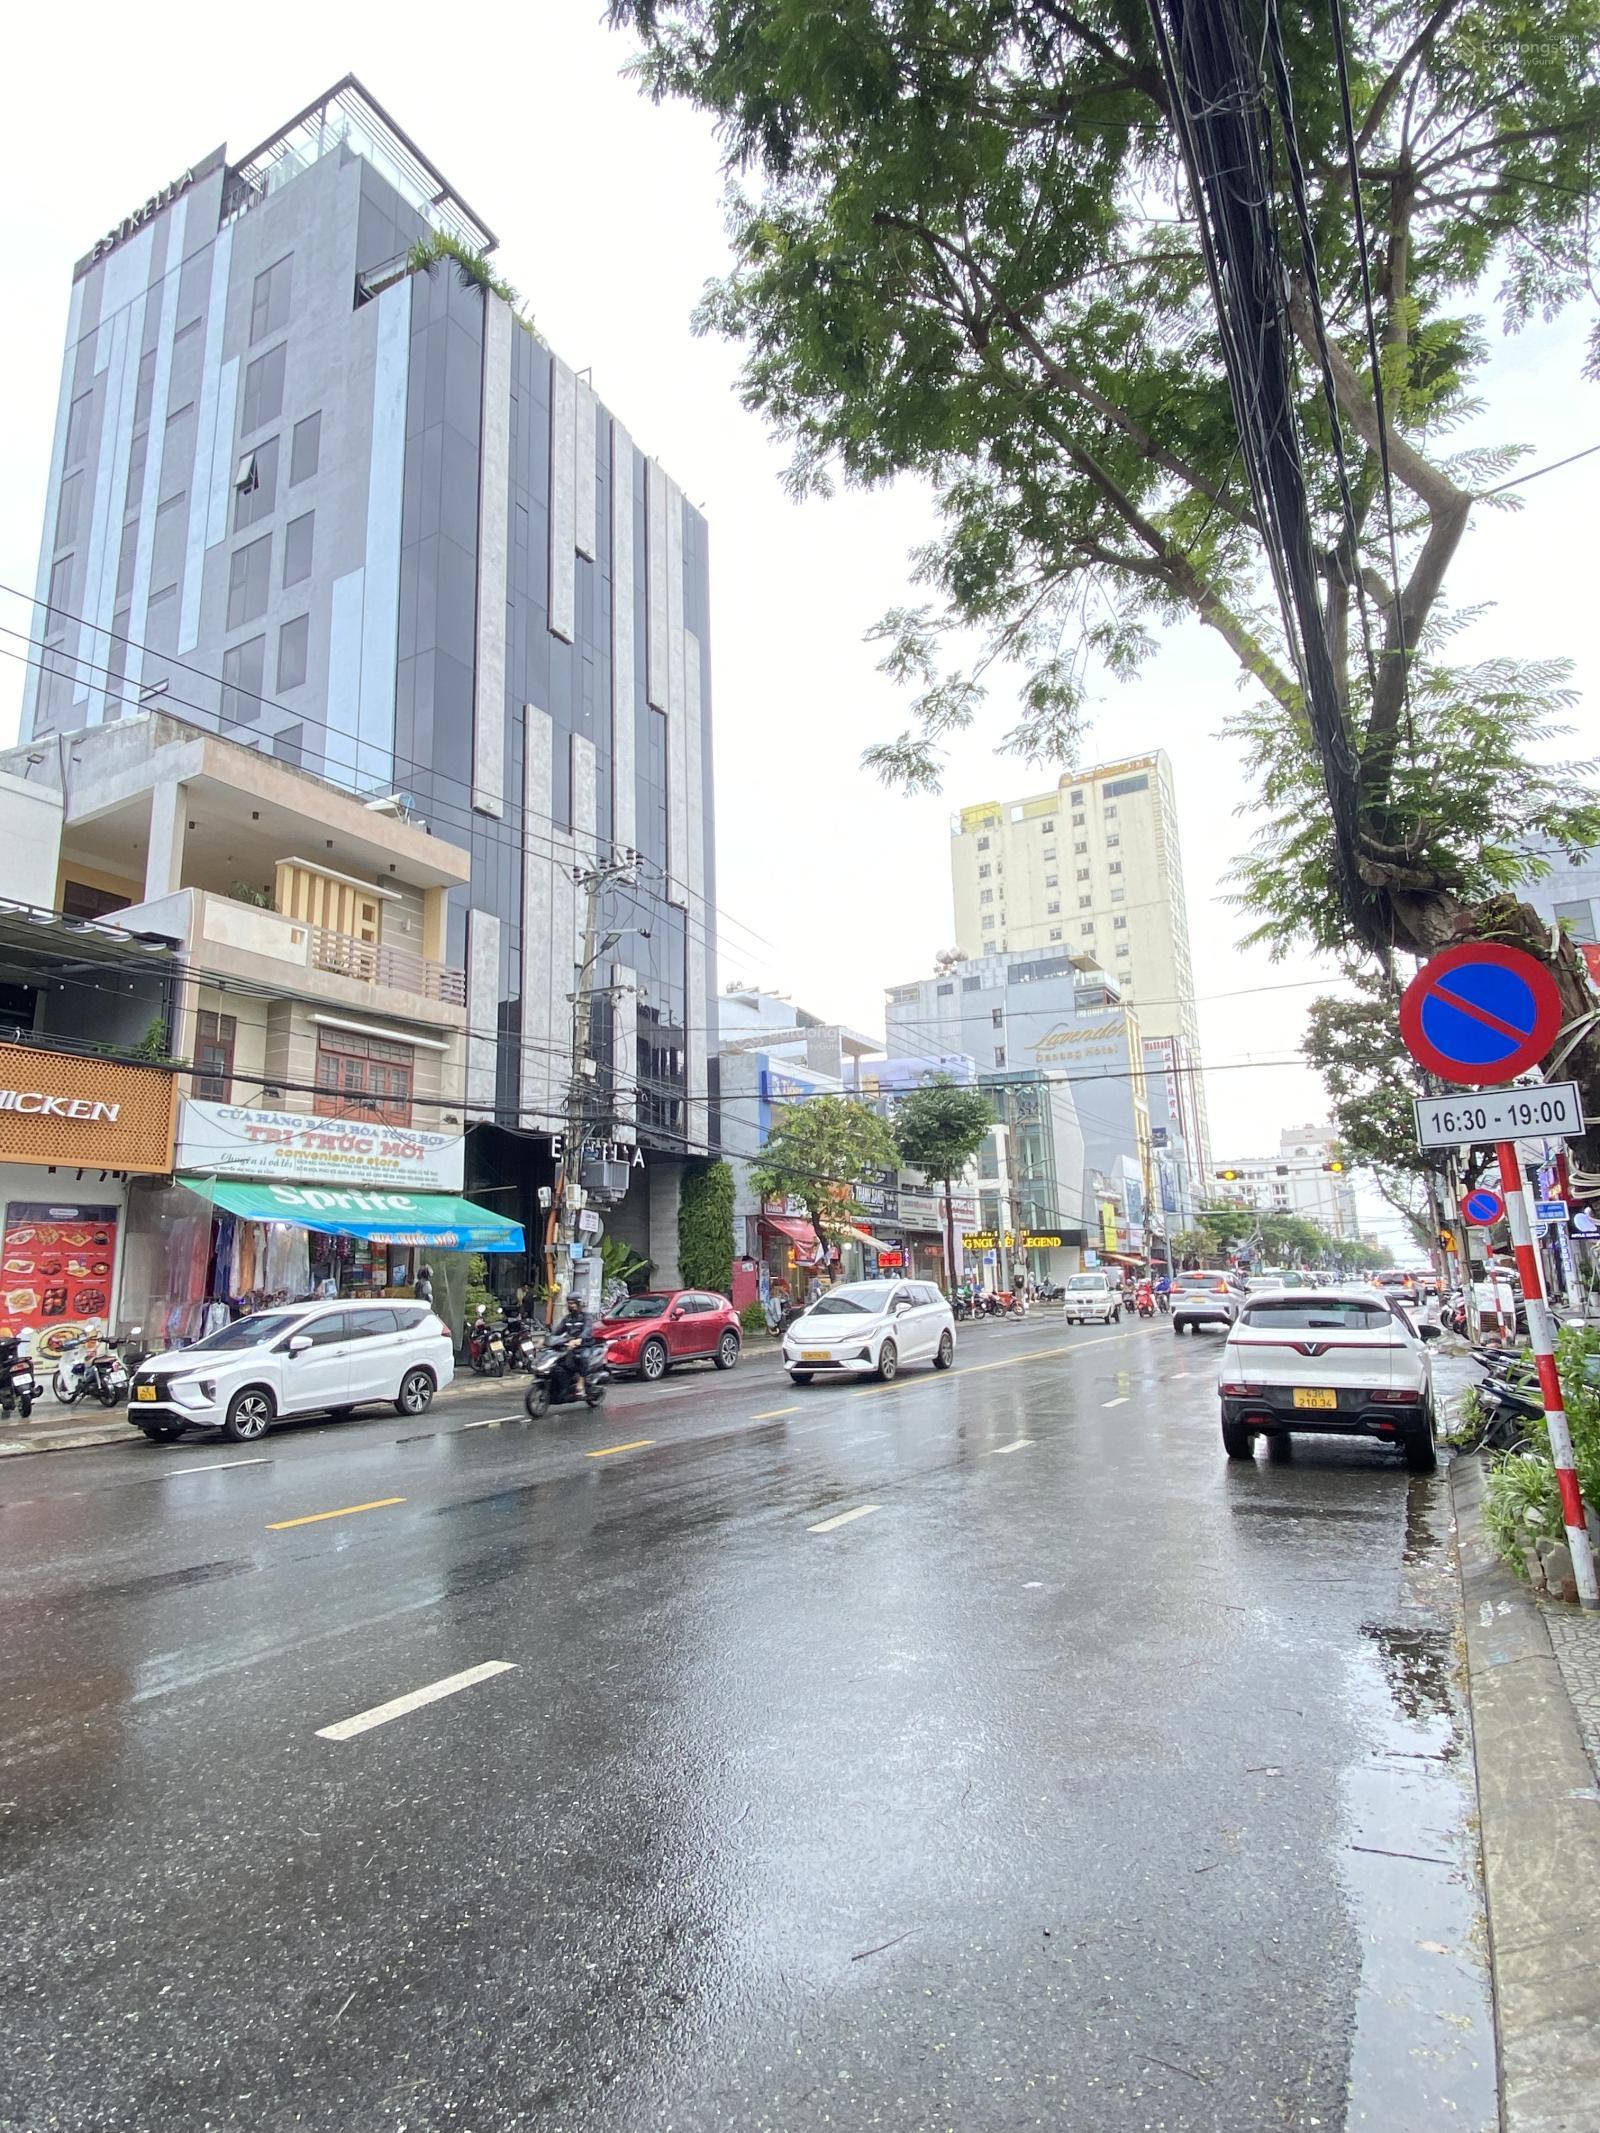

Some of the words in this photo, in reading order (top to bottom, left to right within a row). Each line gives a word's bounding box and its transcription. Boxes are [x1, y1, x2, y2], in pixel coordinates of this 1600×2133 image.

[92, 167, 193, 262] ESTRELLA
[256, 1110, 304, 1129] HÀNG
[305, 1114, 347, 1133] BÁCH
[349, 1119, 379, 1138] HÓA
[1432, 1108, 1487, 1134] 16:30
[1508, 1100, 1566, 1127] 19:00
[274, 1147, 365, 1165] convenience
[365, 1156, 400, 1168] store
[268, 1183, 418, 1210] Sprite
[1021, 1236, 1062, 1248] LEGEND
